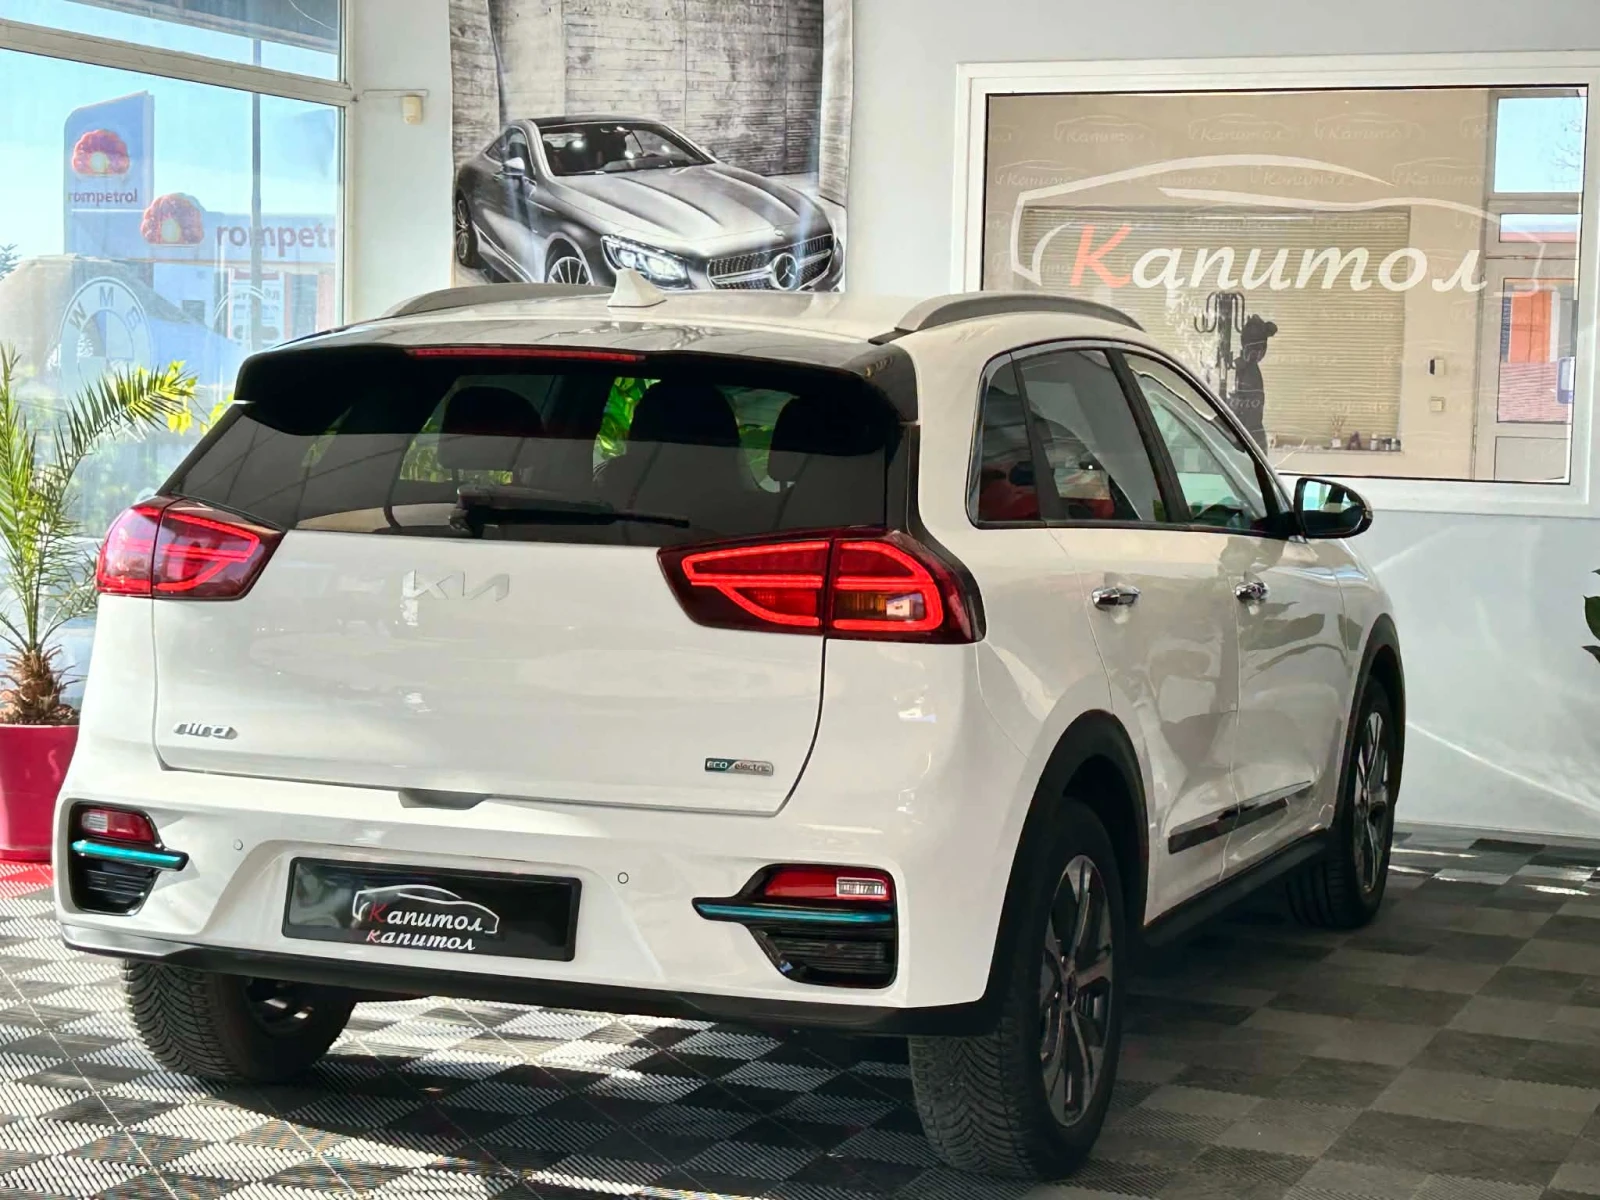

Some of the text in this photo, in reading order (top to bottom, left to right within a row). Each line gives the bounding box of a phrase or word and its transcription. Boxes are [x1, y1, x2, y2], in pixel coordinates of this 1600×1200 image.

[68, 188, 138, 205] rompetrol
[1069, 223, 1489, 294] Капитол
[402, 569, 510, 603] KIA
[368, 902, 483, 932] Капитол
